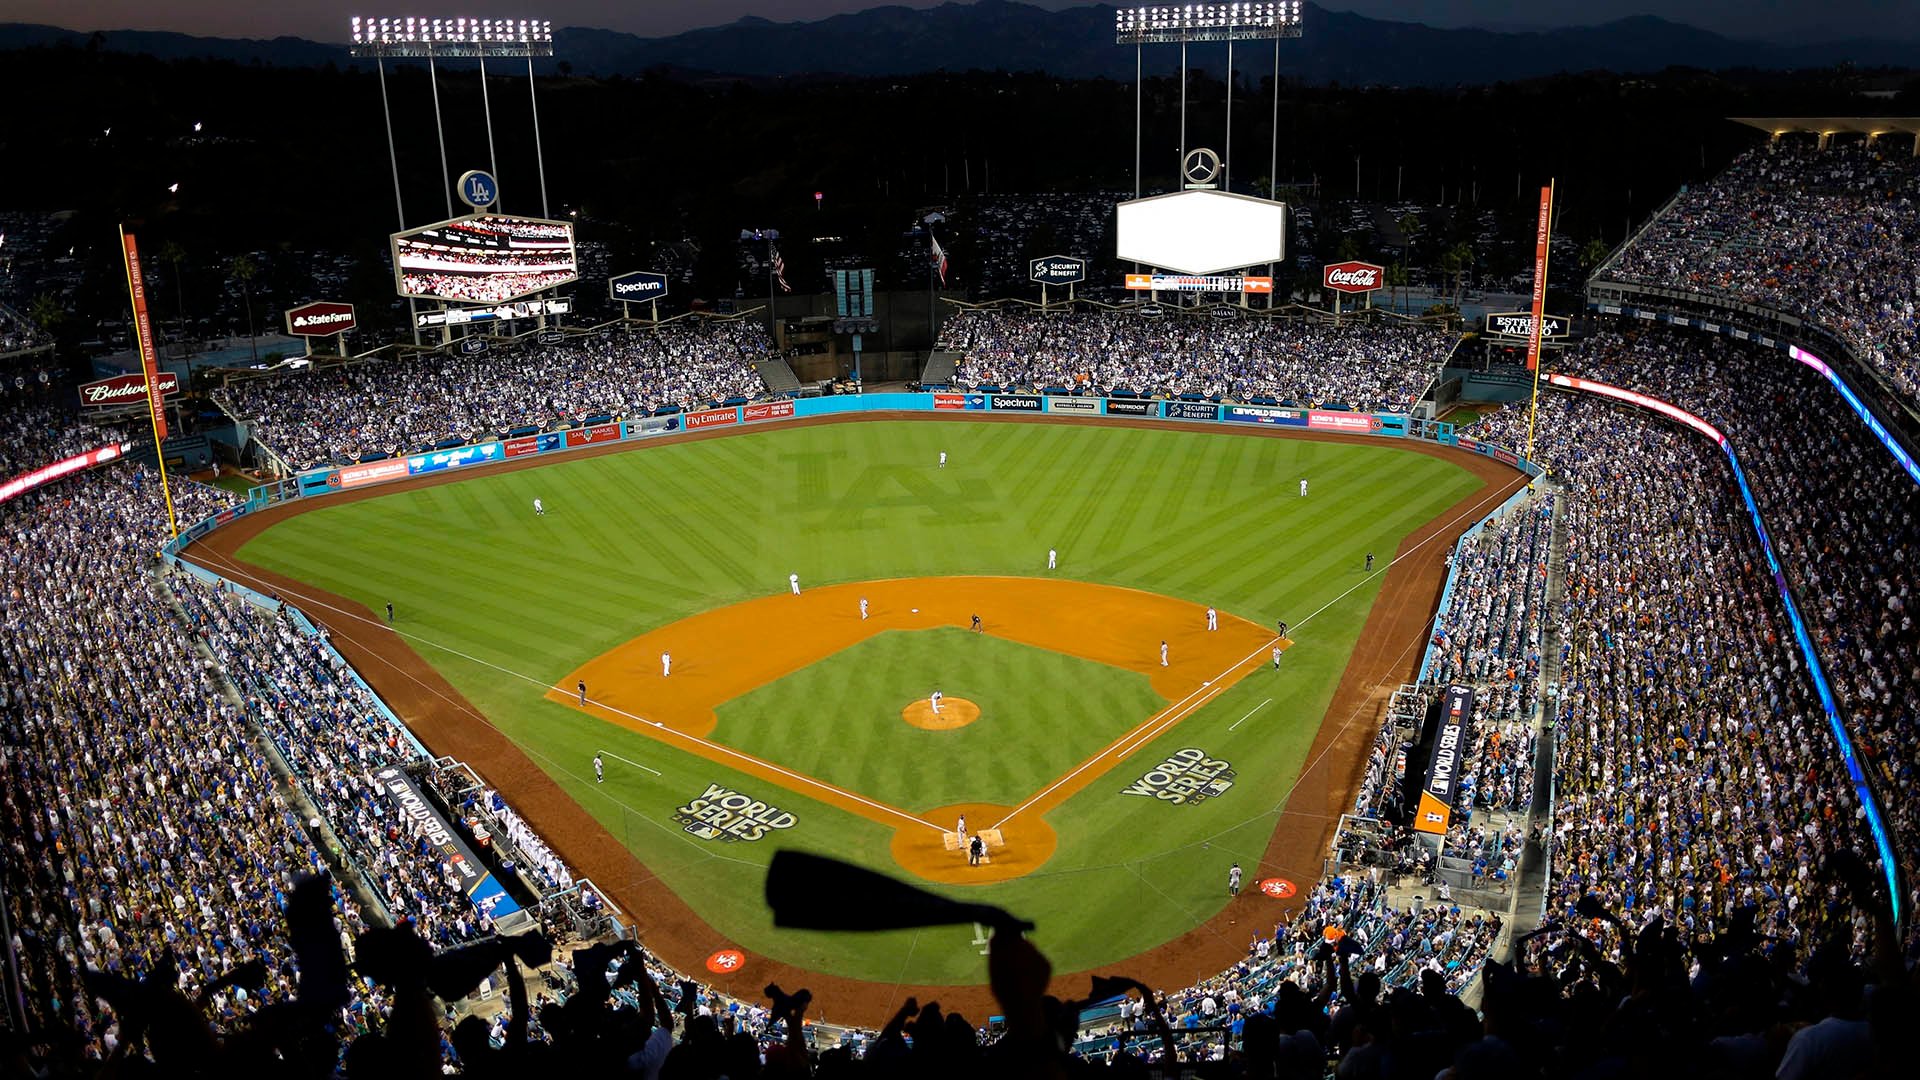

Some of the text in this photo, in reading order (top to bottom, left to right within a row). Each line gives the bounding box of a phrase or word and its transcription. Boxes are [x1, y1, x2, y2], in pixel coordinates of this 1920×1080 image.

[470, 177, 490, 202] LA
[616, 282, 660, 294] Spectrum
[1328, 268, 1378, 286] Coca-Cola
[84, 379, 175, 402] Budweer
[994, 398, 1037, 408] Spectrum
[1183, 404, 1215, 412] SECURITY
[1243, 408, 1268, 416] WORLD
[1269, 410, 1292, 418] SERIES
[592, 426, 614, 435] MANUEL
[686, 416, 700, 425] Fly
[701, 412, 736, 423] Emirates
[1438, 724, 1461, 751] SERIES
[1122, 748, 1204, 796] WORLD
[1433, 750, 1455, 781] WORLD
[1156, 758, 1229, 804] SERIES
[396, 786, 429, 820] WORLD
[423, 816, 452, 846] SERIES
[701, 784, 798, 828] WORLD
[678, 800, 772, 841] SERIES
